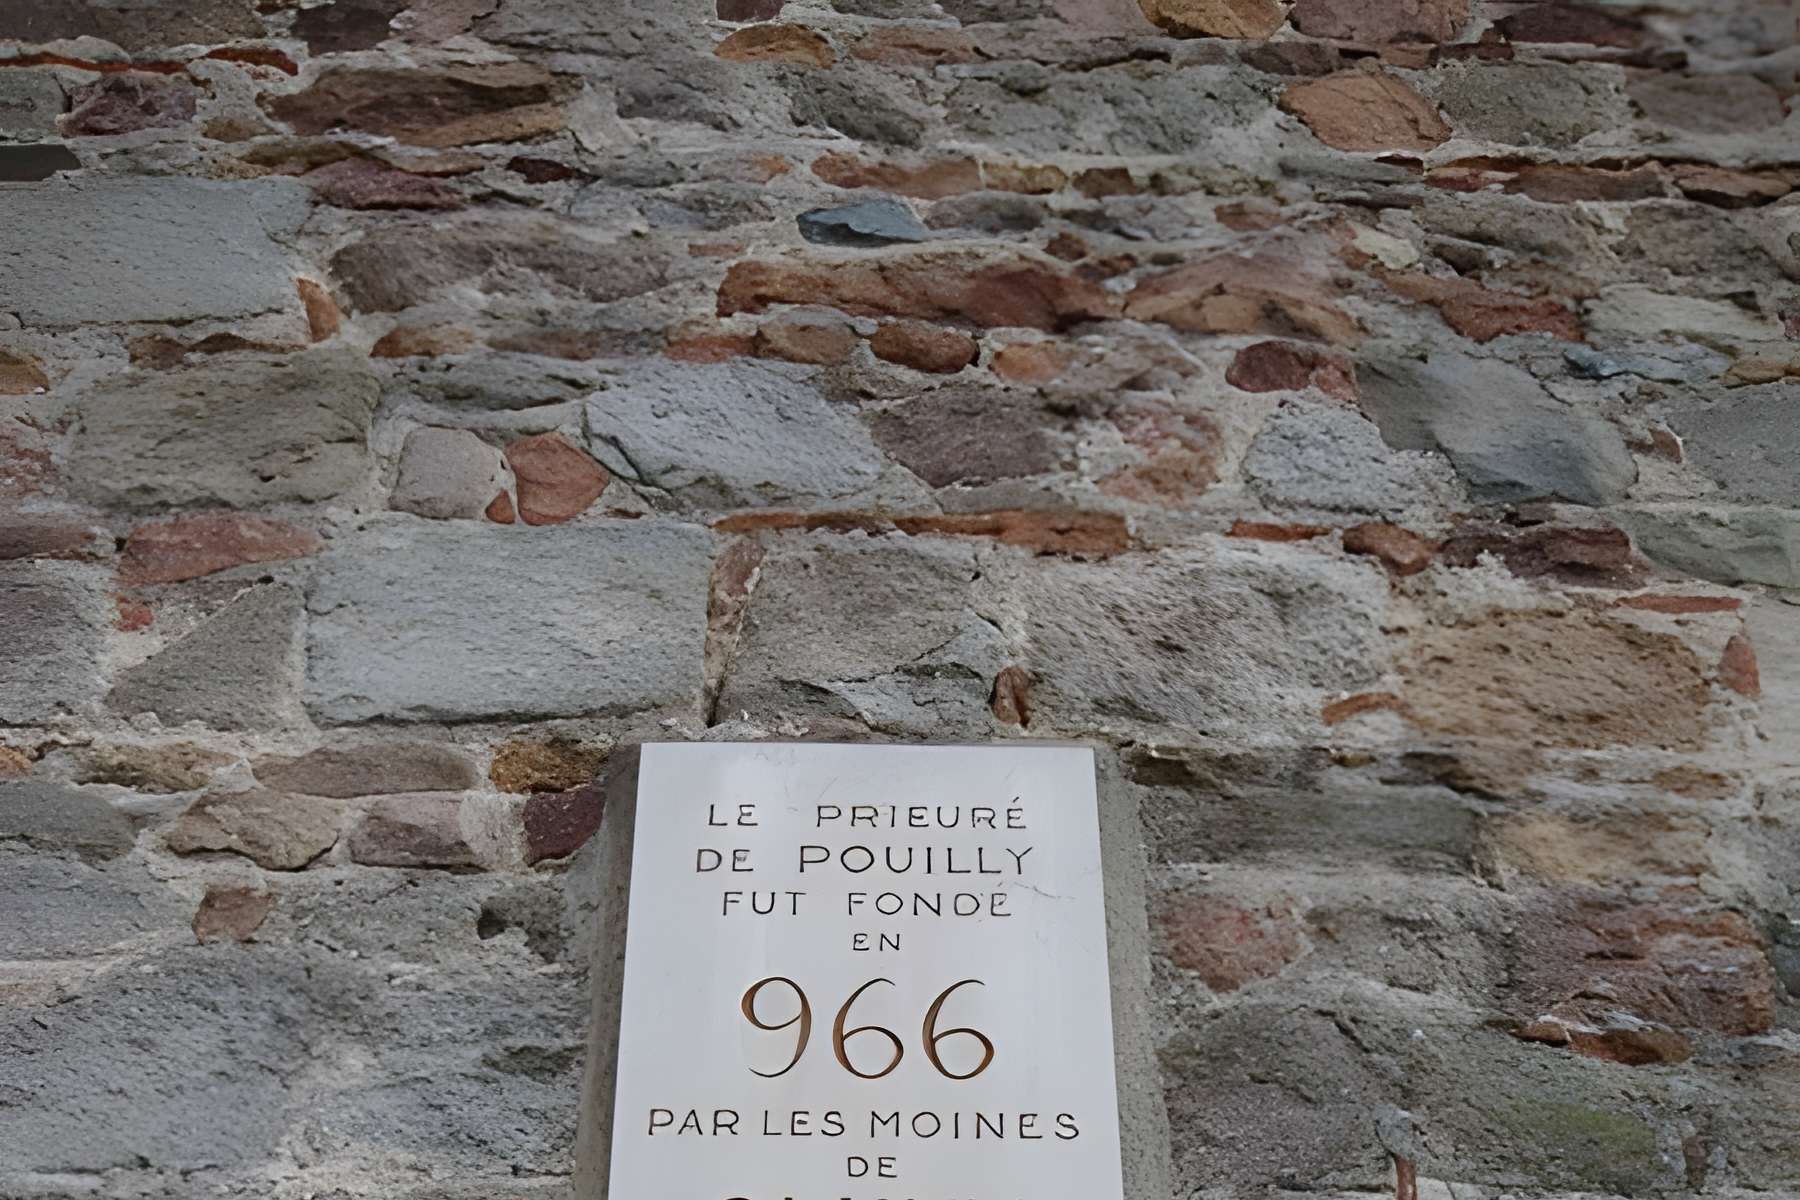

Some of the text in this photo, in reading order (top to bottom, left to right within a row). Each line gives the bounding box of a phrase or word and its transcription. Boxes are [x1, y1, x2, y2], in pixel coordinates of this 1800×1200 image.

[708, 796, 1027, 830] LE PRIEURÉ
[695, 845, 1034, 876] DE POUILLY
[721, 891, 807, 917] FUT
[852, 933, 901, 952] EN
[740, 976, 995, 1081] 966
[647, 1109, 1081, 1141] PAR LES MOINES
[846, 1156, 898, 1179] DE
